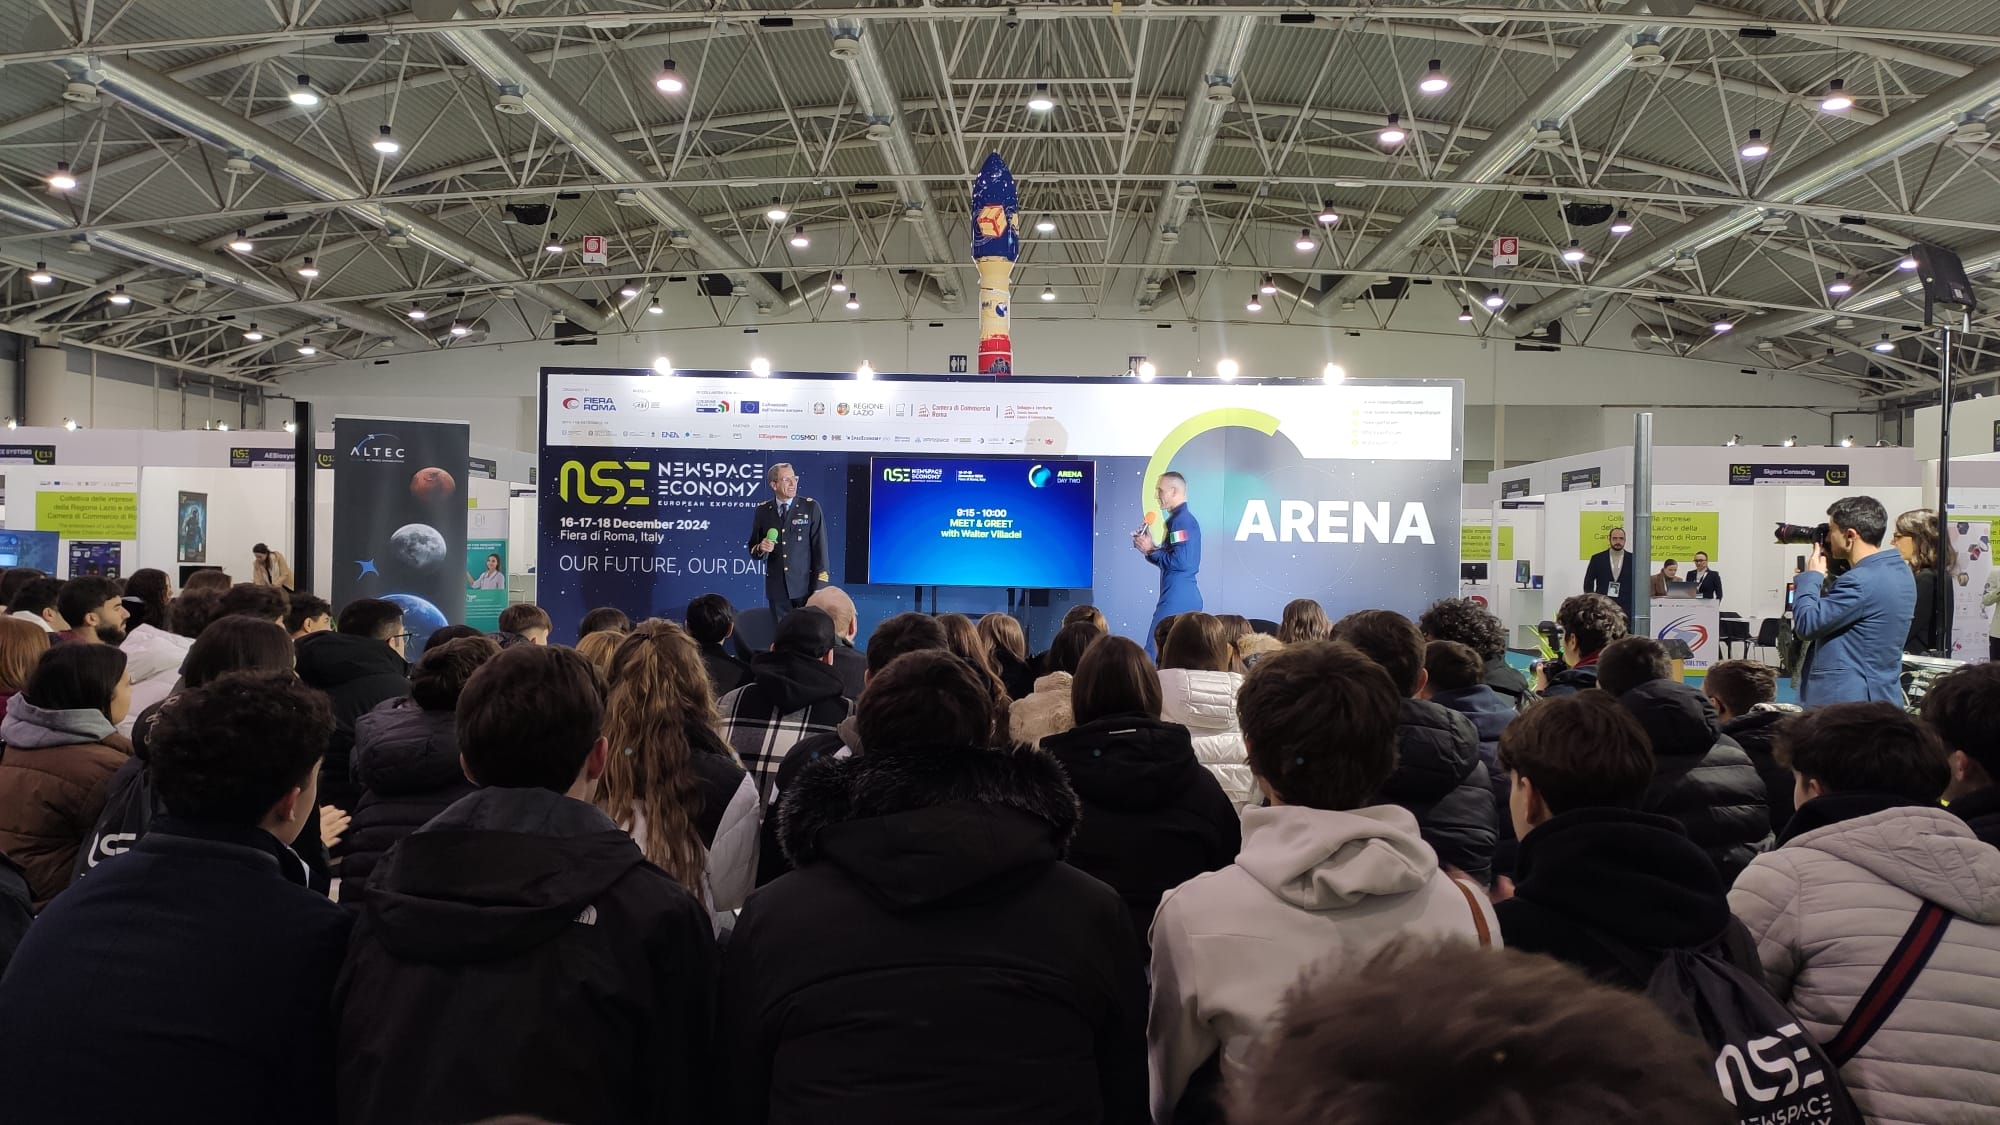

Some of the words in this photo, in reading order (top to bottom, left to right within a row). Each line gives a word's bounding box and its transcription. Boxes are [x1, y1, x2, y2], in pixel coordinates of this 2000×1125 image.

[583, 396, 613, 404] FIERA
[232, 449, 249, 458] NSE
[263, 452, 295, 460] AEBiosys
[350, 446, 405, 458] ALTEC
[658, 461, 764, 479] NEWSPACE
[883, 468, 910, 482] NSE
[1057, 470, 1083, 478] ARENA
[1732, 465, 1751, 475] NSE
[1763, 468, 1782, 476] Sigma
[560, 460, 650, 506] NSE
[658, 480, 761, 497] ECONOMY
[956, 508, 975, 517] 9:15
[982, 509, 1007, 518] 10:00
[560, 517, 611, 528] 16-17-18
[613, 518, 674, 530] December
[676, 519, 708, 530] 2024
[949, 518, 975, 528] MEET
[976, 519, 983, 528] &
[983, 519, 1014, 528] GREET
[1234, 499, 1435, 544] ARENA
[941, 528, 960, 538] with
[961, 529, 989, 538] Walter
[990, 530, 1022, 539] Villadei
[1653, 524, 1673, 532] Lazio
[1681, 524, 1698, 532] della
[560, 530, 588, 541] Fiera
[590, 530, 601, 541] di
[603, 531, 638, 543] Roma,
[640, 532, 665, 545] Italy
[1676, 533, 1684, 541] di
[559, 554, 599, 572] OUR
[604, 555, 681, 577] FUTURE,
[688, 557, 728, 575] OUR
[733, 558, 767, 575] DAIL
[1714, 1022, 1825, 1106] NSE
